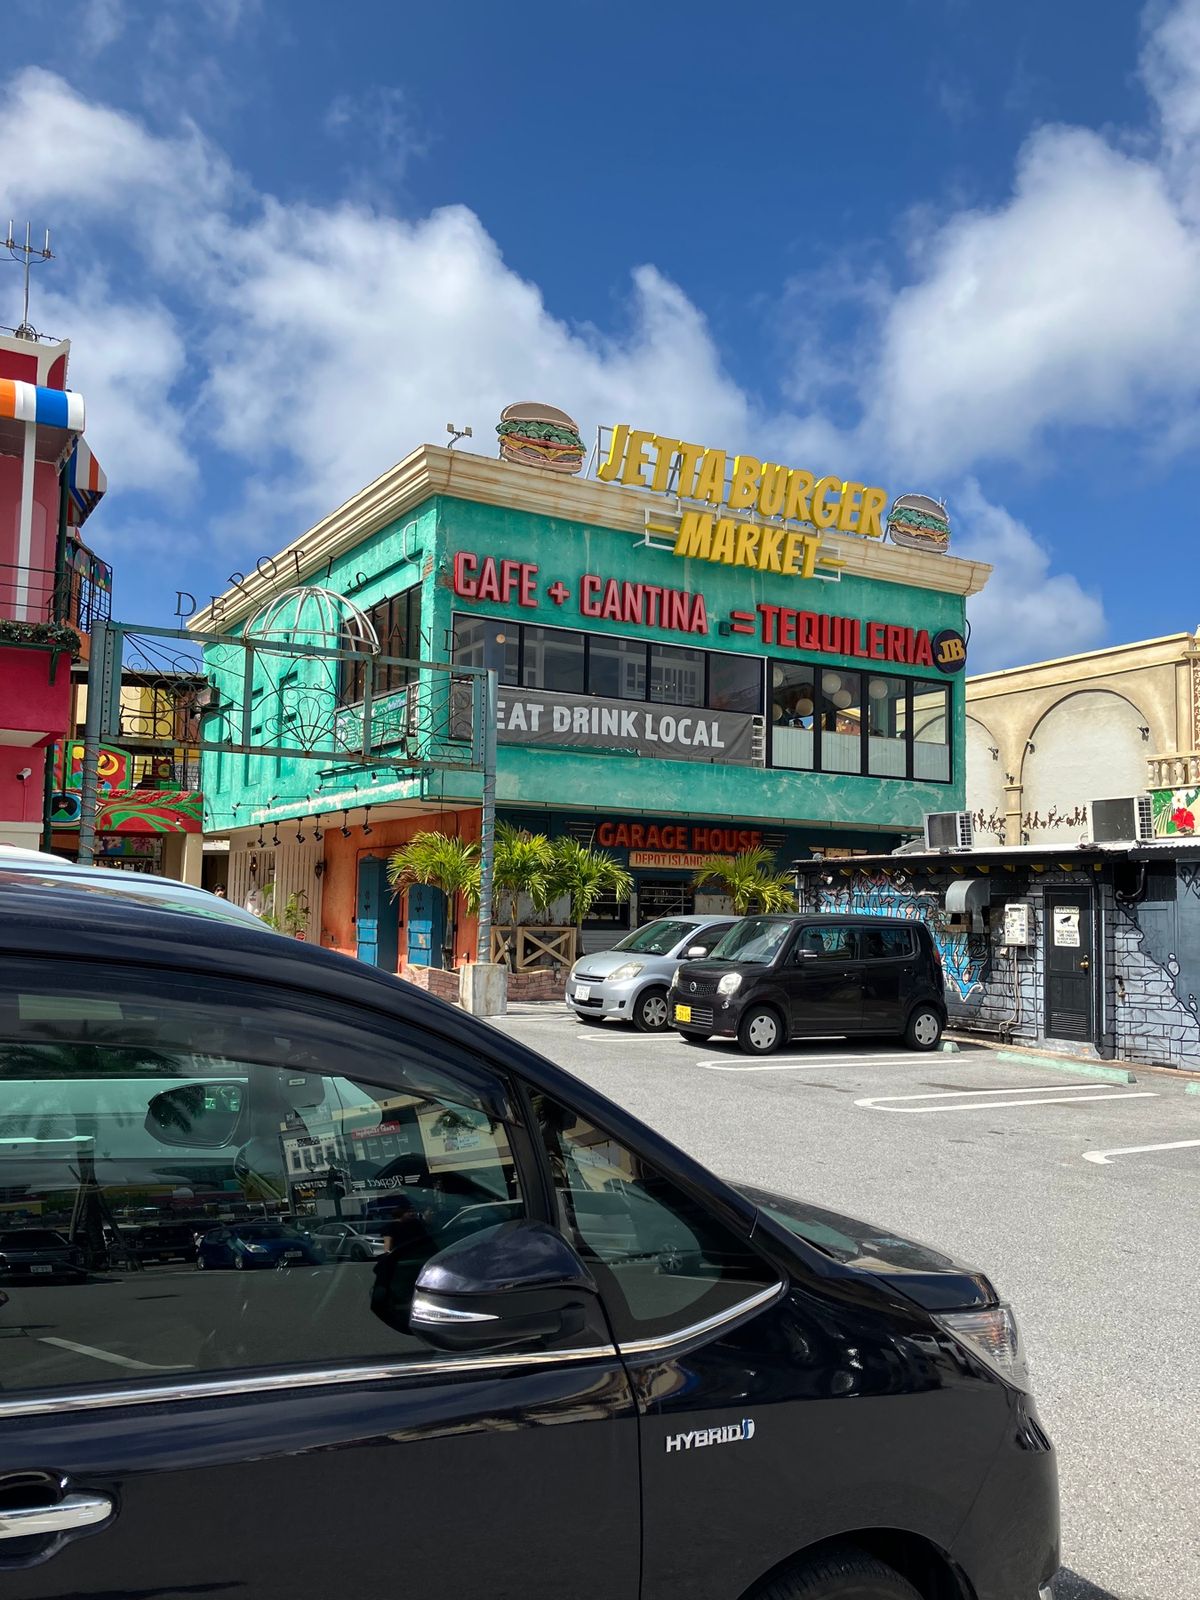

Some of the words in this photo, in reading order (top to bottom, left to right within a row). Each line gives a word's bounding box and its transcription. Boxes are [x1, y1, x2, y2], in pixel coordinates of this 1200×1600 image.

[597, 424, 726, 504] JETTA
[727, 455, 888, 538] BURGER
[673, 512, 822, 579] MARKET
[174, 550, 305, 622] DEPOT
[324, 555, 462, 652] ISLAND
[454, 551, 538, 607] CAFE
[547, 581, 570, 604] +
[580, 574, 708, 635] CANTINA
[756, 604, 934, 667] TEQUILERIA
[937, 638, 965, 665] JB
[497, 701, 544, 732] EAT
[553, 705, 639, 738] DRINK
[644, 713, 725, 748] LOCAL
[598, 822, 688, 850] GARAGE
[692, 828, 763, 853] HOUSE
[635, 853, 667, 865] DEPOT
[667, 854, 705, 866] ISLAND
[666, 1423, 743, 1453] HYBRID
